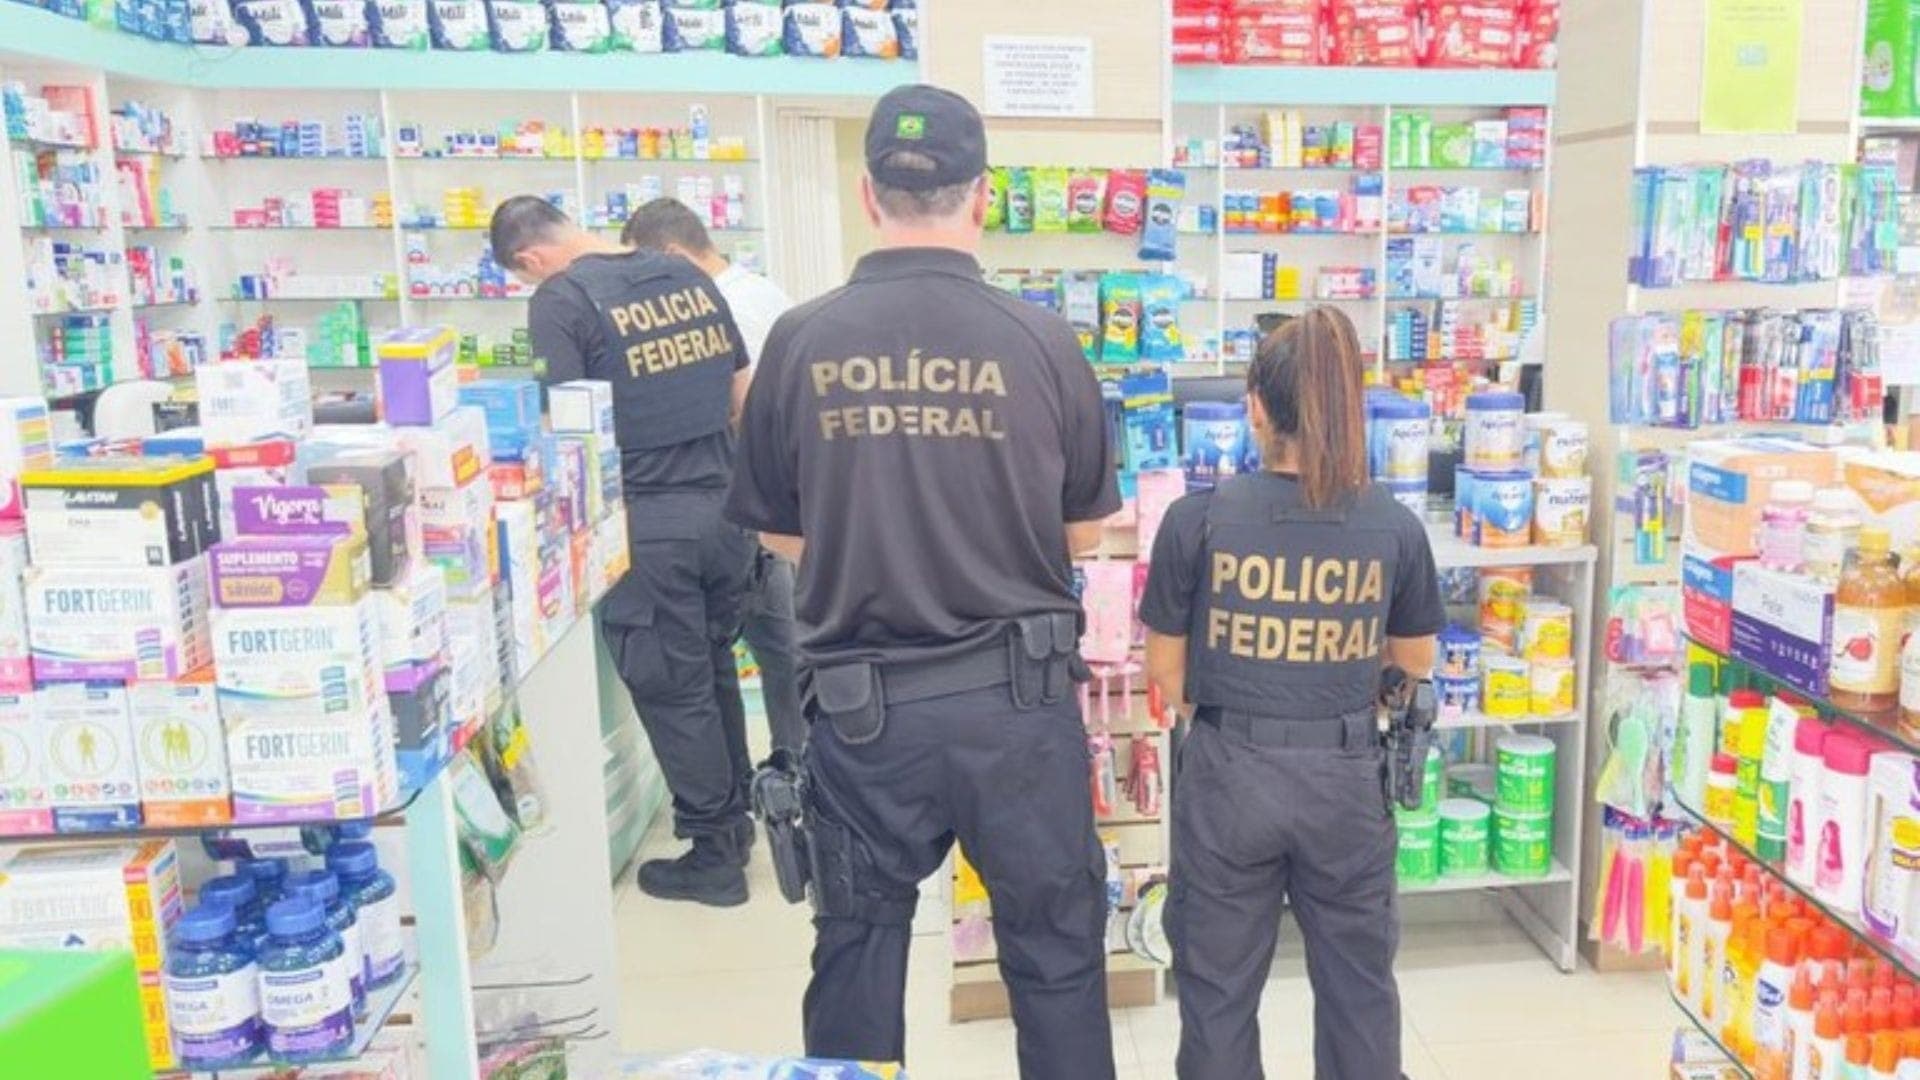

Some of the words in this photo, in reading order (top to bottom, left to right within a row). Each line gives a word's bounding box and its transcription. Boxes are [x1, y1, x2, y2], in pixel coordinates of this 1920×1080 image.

[625, 324, 733, 378] FEDERAL
[810, 349, 1007, 397] POLÍCIA
[819, 405, 1006, 440] FEDERAL
[1212, 552, 1384, 604] POLICIA
[44, 588, 152, 613] FORTGERIN
[228, 627, 334, 655] FORTGERIN
[1207, 607, 1380, 663] FEDERAL
[246, 731, 349, 760] FORTGERIN
